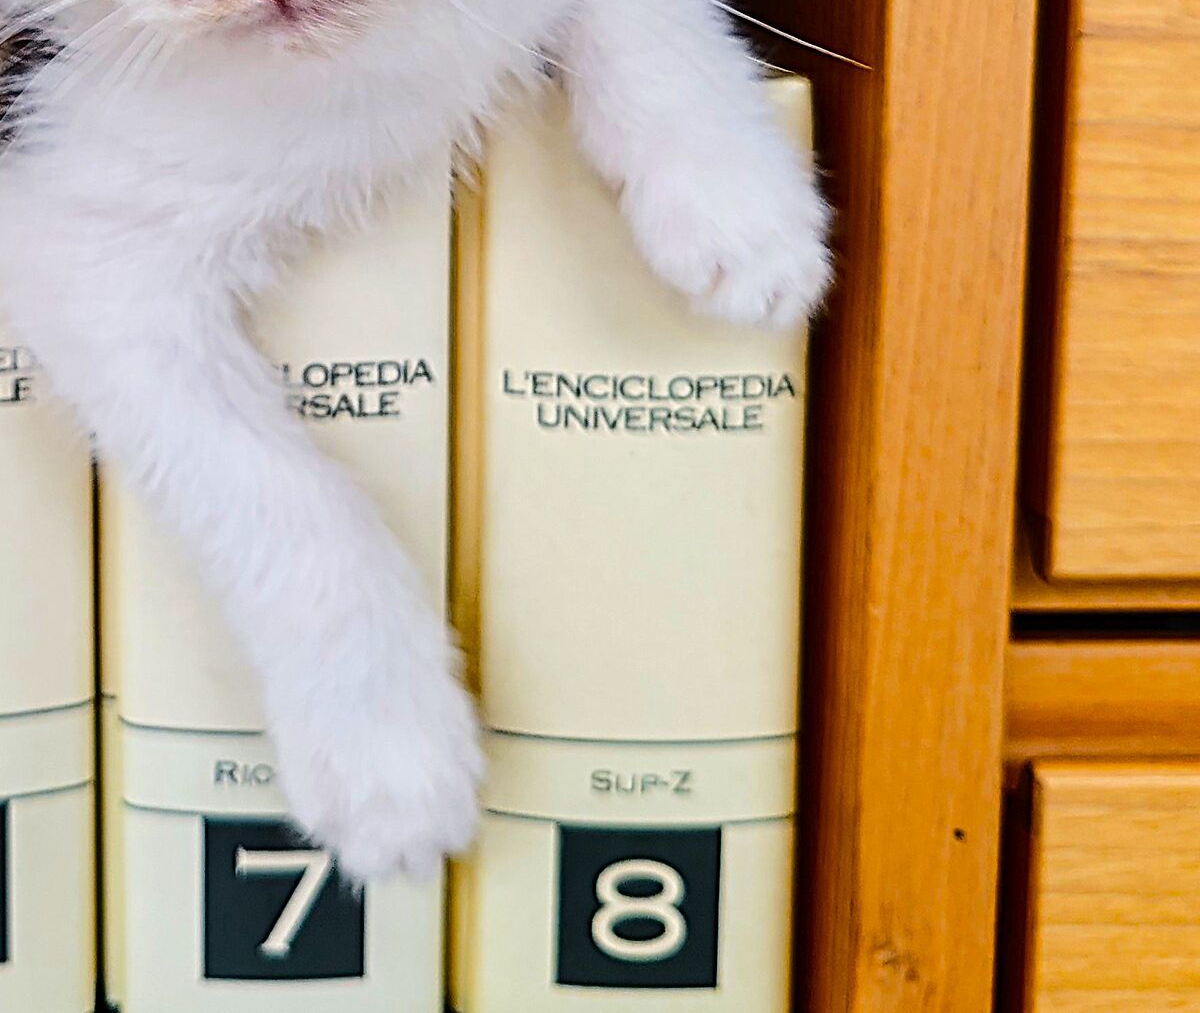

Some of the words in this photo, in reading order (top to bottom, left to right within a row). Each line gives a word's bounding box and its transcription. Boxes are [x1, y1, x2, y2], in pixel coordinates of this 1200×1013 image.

[271, 359, 434, 388] LOPEDIA
[503, 368, 796, 402] L'ENCICLOPEDIA
[537, 403, 764, 433] UNIVERSALE
[235, 845, 336, 959] 7
[592, 858, 687, 962] 8
